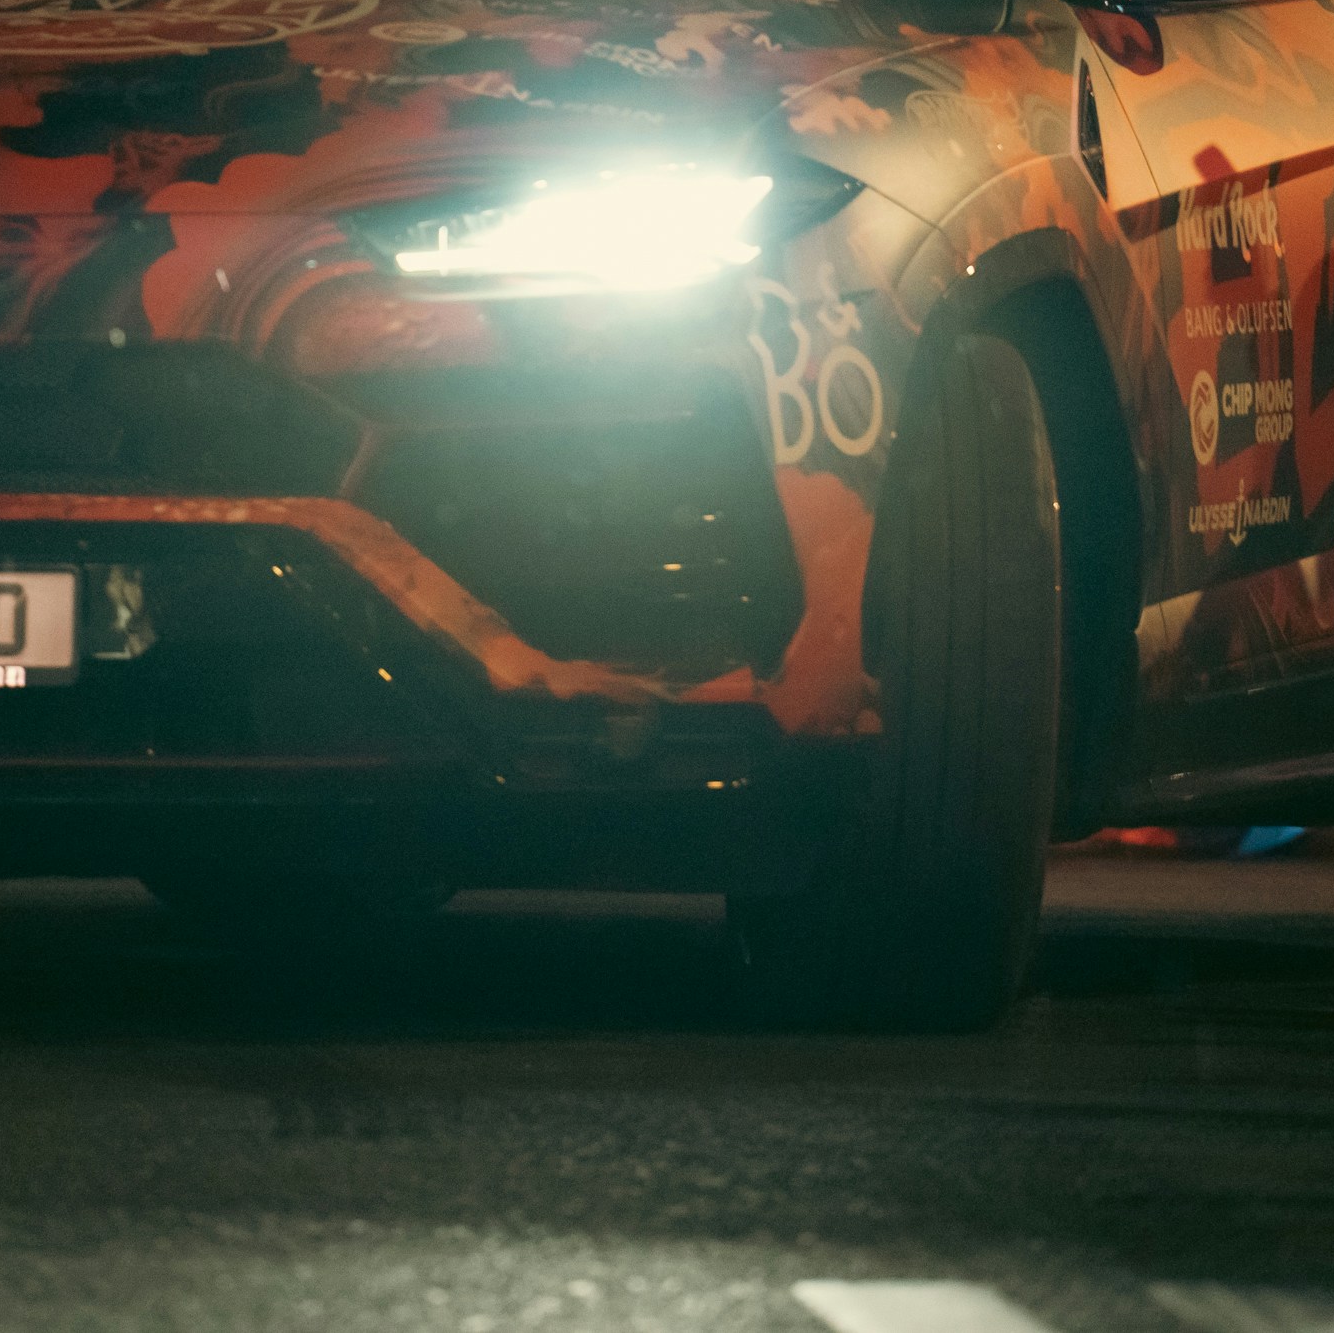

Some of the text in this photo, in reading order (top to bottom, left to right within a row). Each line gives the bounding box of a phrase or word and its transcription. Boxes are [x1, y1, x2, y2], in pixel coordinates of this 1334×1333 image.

[1176, 178, 1283, 263] Hard Rock
[1184, 298, 1293, 339] BANG & OLUFSEN
[1222, 378, 1294, 418] CHIP MONG
[1254, 412, 1294, 444] GROUP
[1189, 495, 1291, 533] ULYSSE NARDIN
